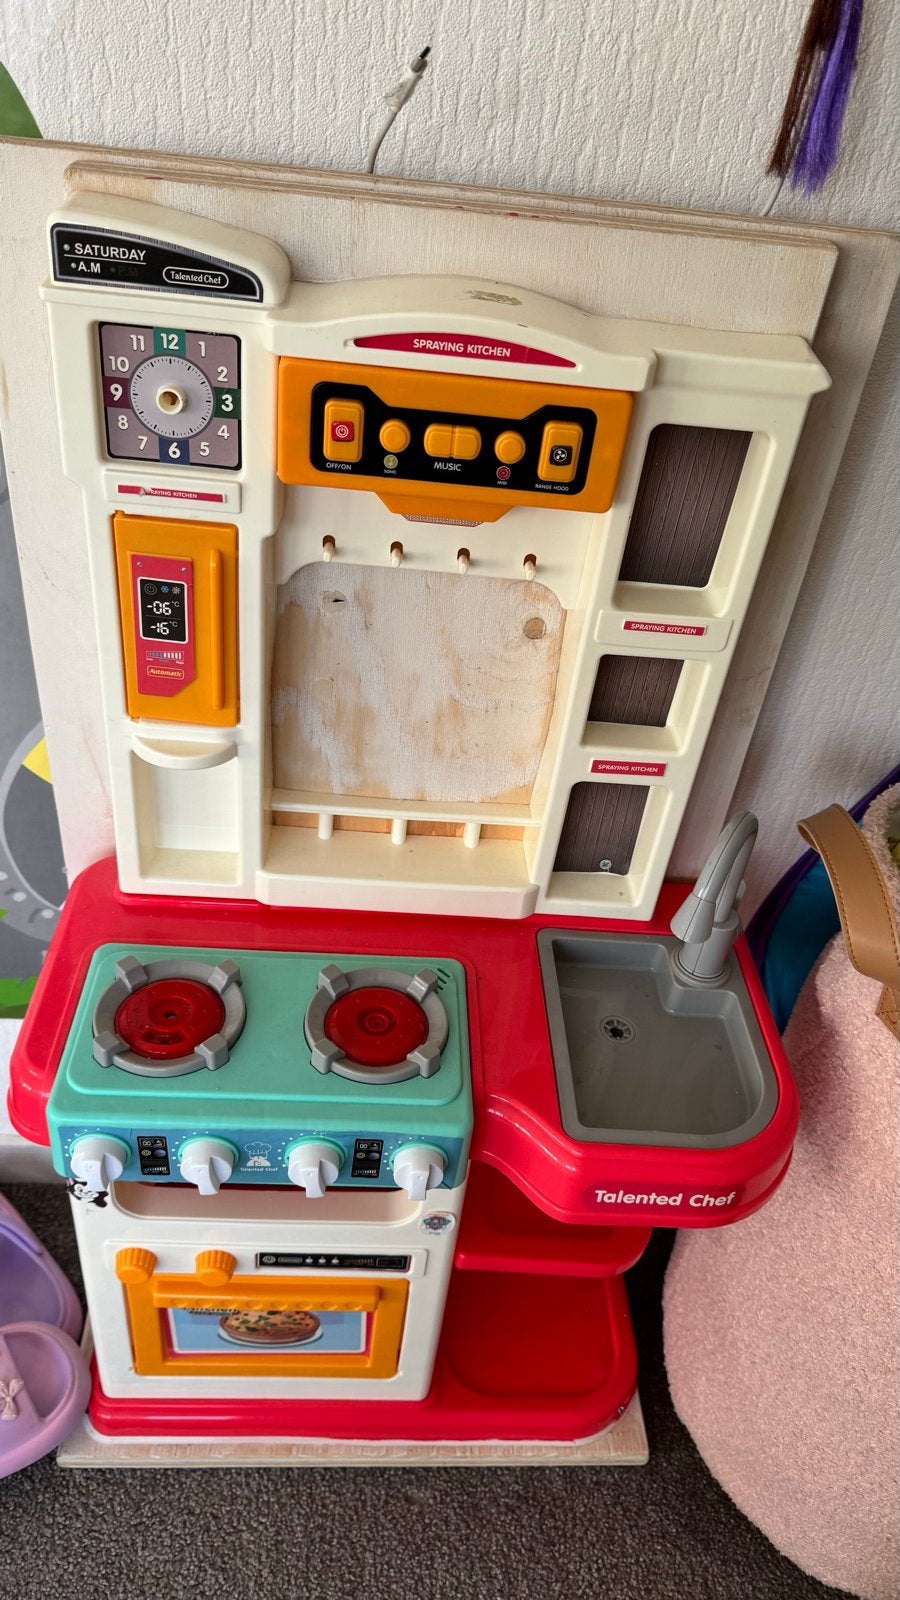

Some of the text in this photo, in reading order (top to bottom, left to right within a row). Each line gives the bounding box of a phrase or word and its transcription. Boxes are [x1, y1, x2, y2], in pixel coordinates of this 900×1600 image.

[74, 242, 146, 261] SATURDAY
[78, 261, 101, 274] A.M
[170, 271, 221, 285] Talented Chef
[130, 334, 145, 352] 11
[160, 333, 179, 350] 12
[198, 341, 206, 357] 1
[413, 338, 511, 357] SPRAYING KITCHEN
[108, 356, 130, 372] 10
[217, 366, 229, 382] 2
[110, 383, 123, 402] 9
[221, 394, 234, 412] 3
[117, 414, 129, 430] 8
[217, 425, 230, 440] 4
[137, 435, 148, 450] 7
[168, 442, 181, 459] 6
[199, 442, 210, 456] 5
[325, 462, 352, 470] OFF/ON
[433, 461, 462, 472] MUSIC
[173, 491, 198, 499] KITCHEN
[146, 600, 172, 616] -06
[150, 622, 170, 635] -16
[631, 623, 697, 635] SPRAYING KITCHEN
[149, 668, 183, 678] Automatic
[598, 764, 630, 772] SPRAYING
[595, 1190, 736, 1207] Talented Chef
